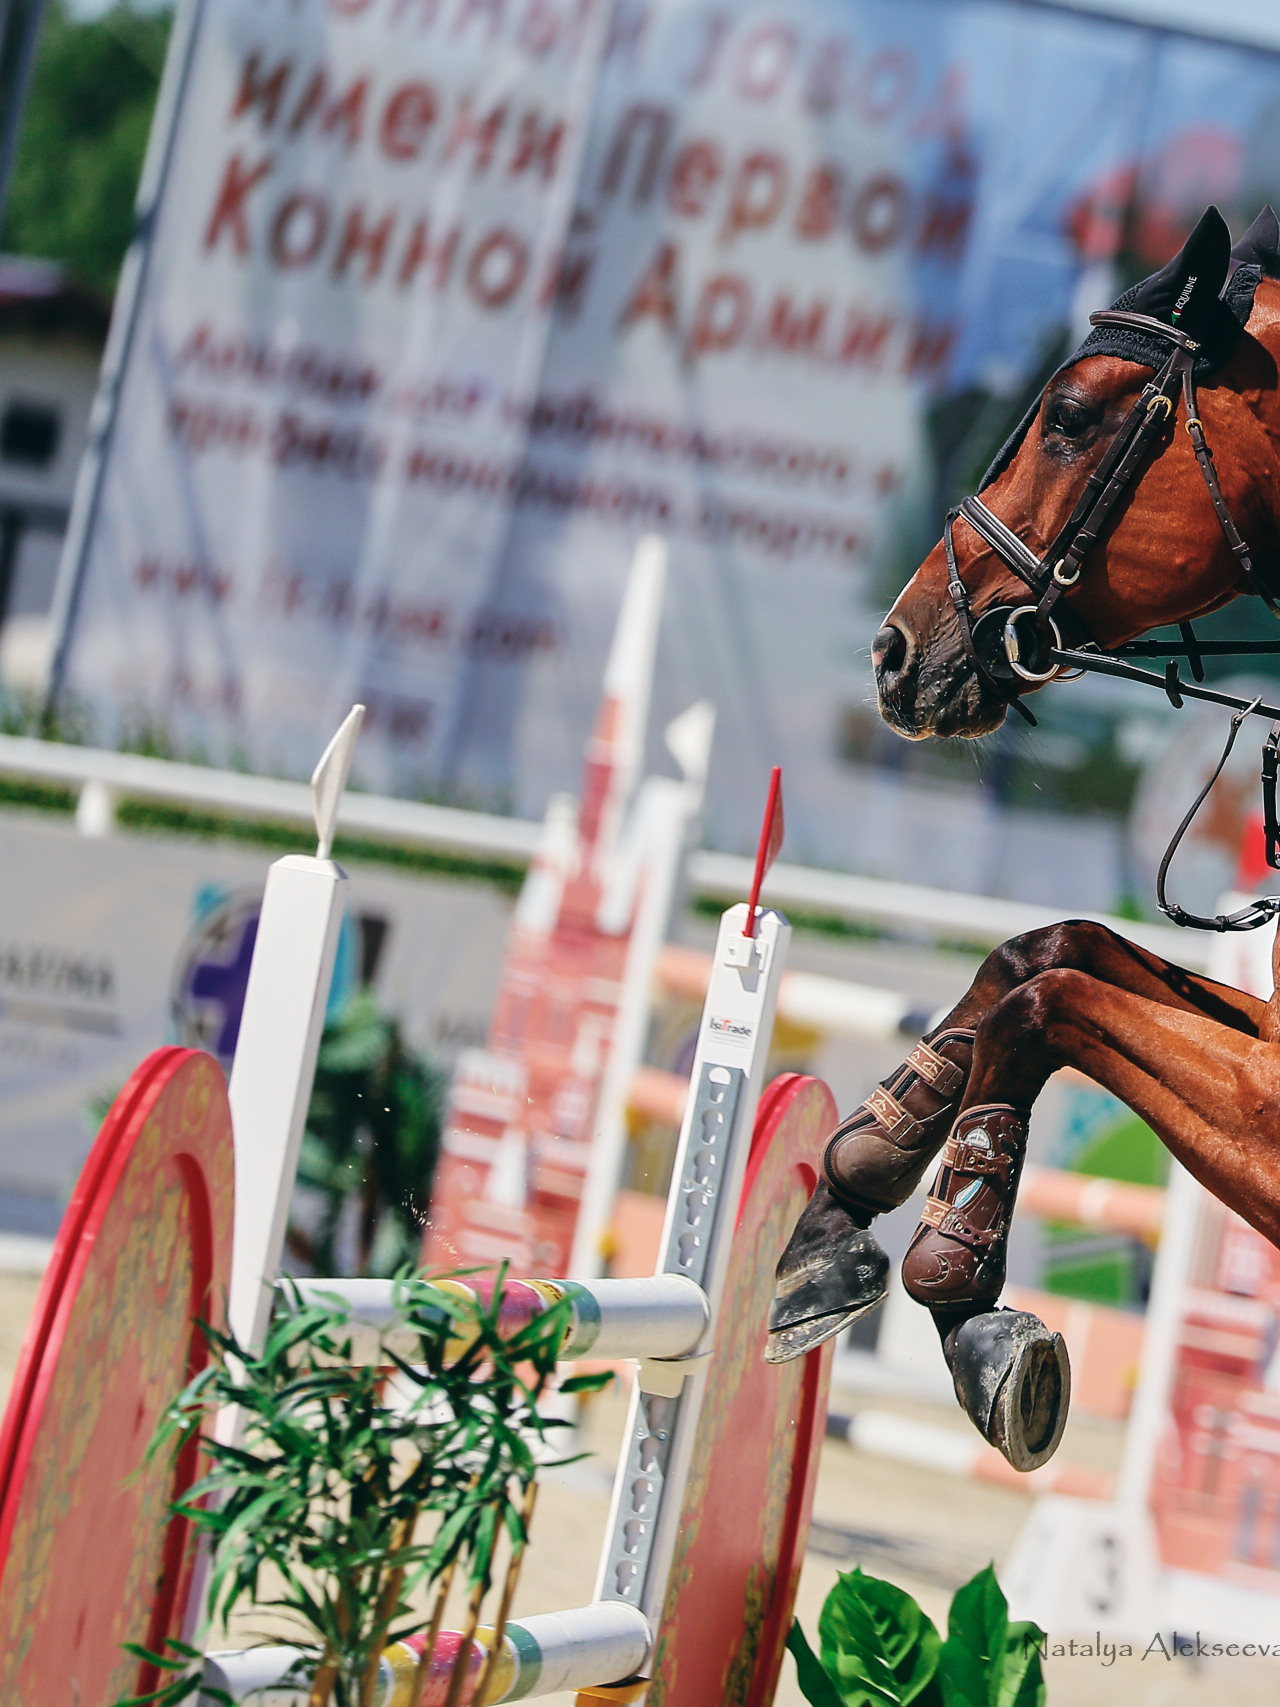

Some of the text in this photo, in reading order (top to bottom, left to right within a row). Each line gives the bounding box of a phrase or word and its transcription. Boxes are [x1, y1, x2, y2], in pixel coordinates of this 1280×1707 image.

[227, 48, 978, 262] имени Первой
[205, 150, 962, 390] Конной Армии
[1175, 275, 1198, 310] EQUILINE
